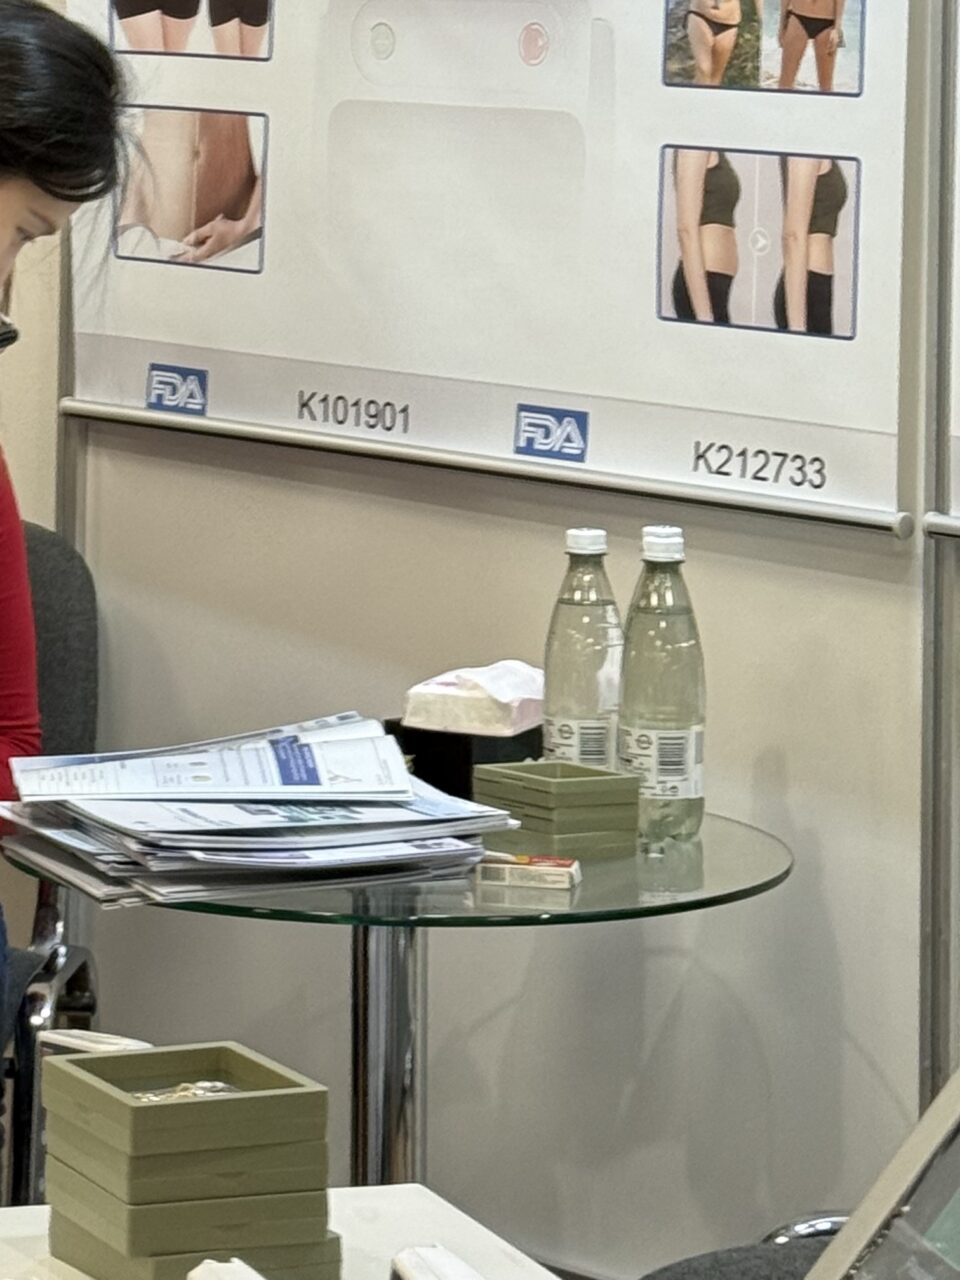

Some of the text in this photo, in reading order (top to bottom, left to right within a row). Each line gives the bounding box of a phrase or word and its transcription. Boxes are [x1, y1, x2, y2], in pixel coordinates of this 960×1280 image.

[148, 370, 206, 409] FDA
[298, 389, 410, 434] K101901
[517, 410, 586, 455] FDA
[692, 440, 827, 489] K212733
